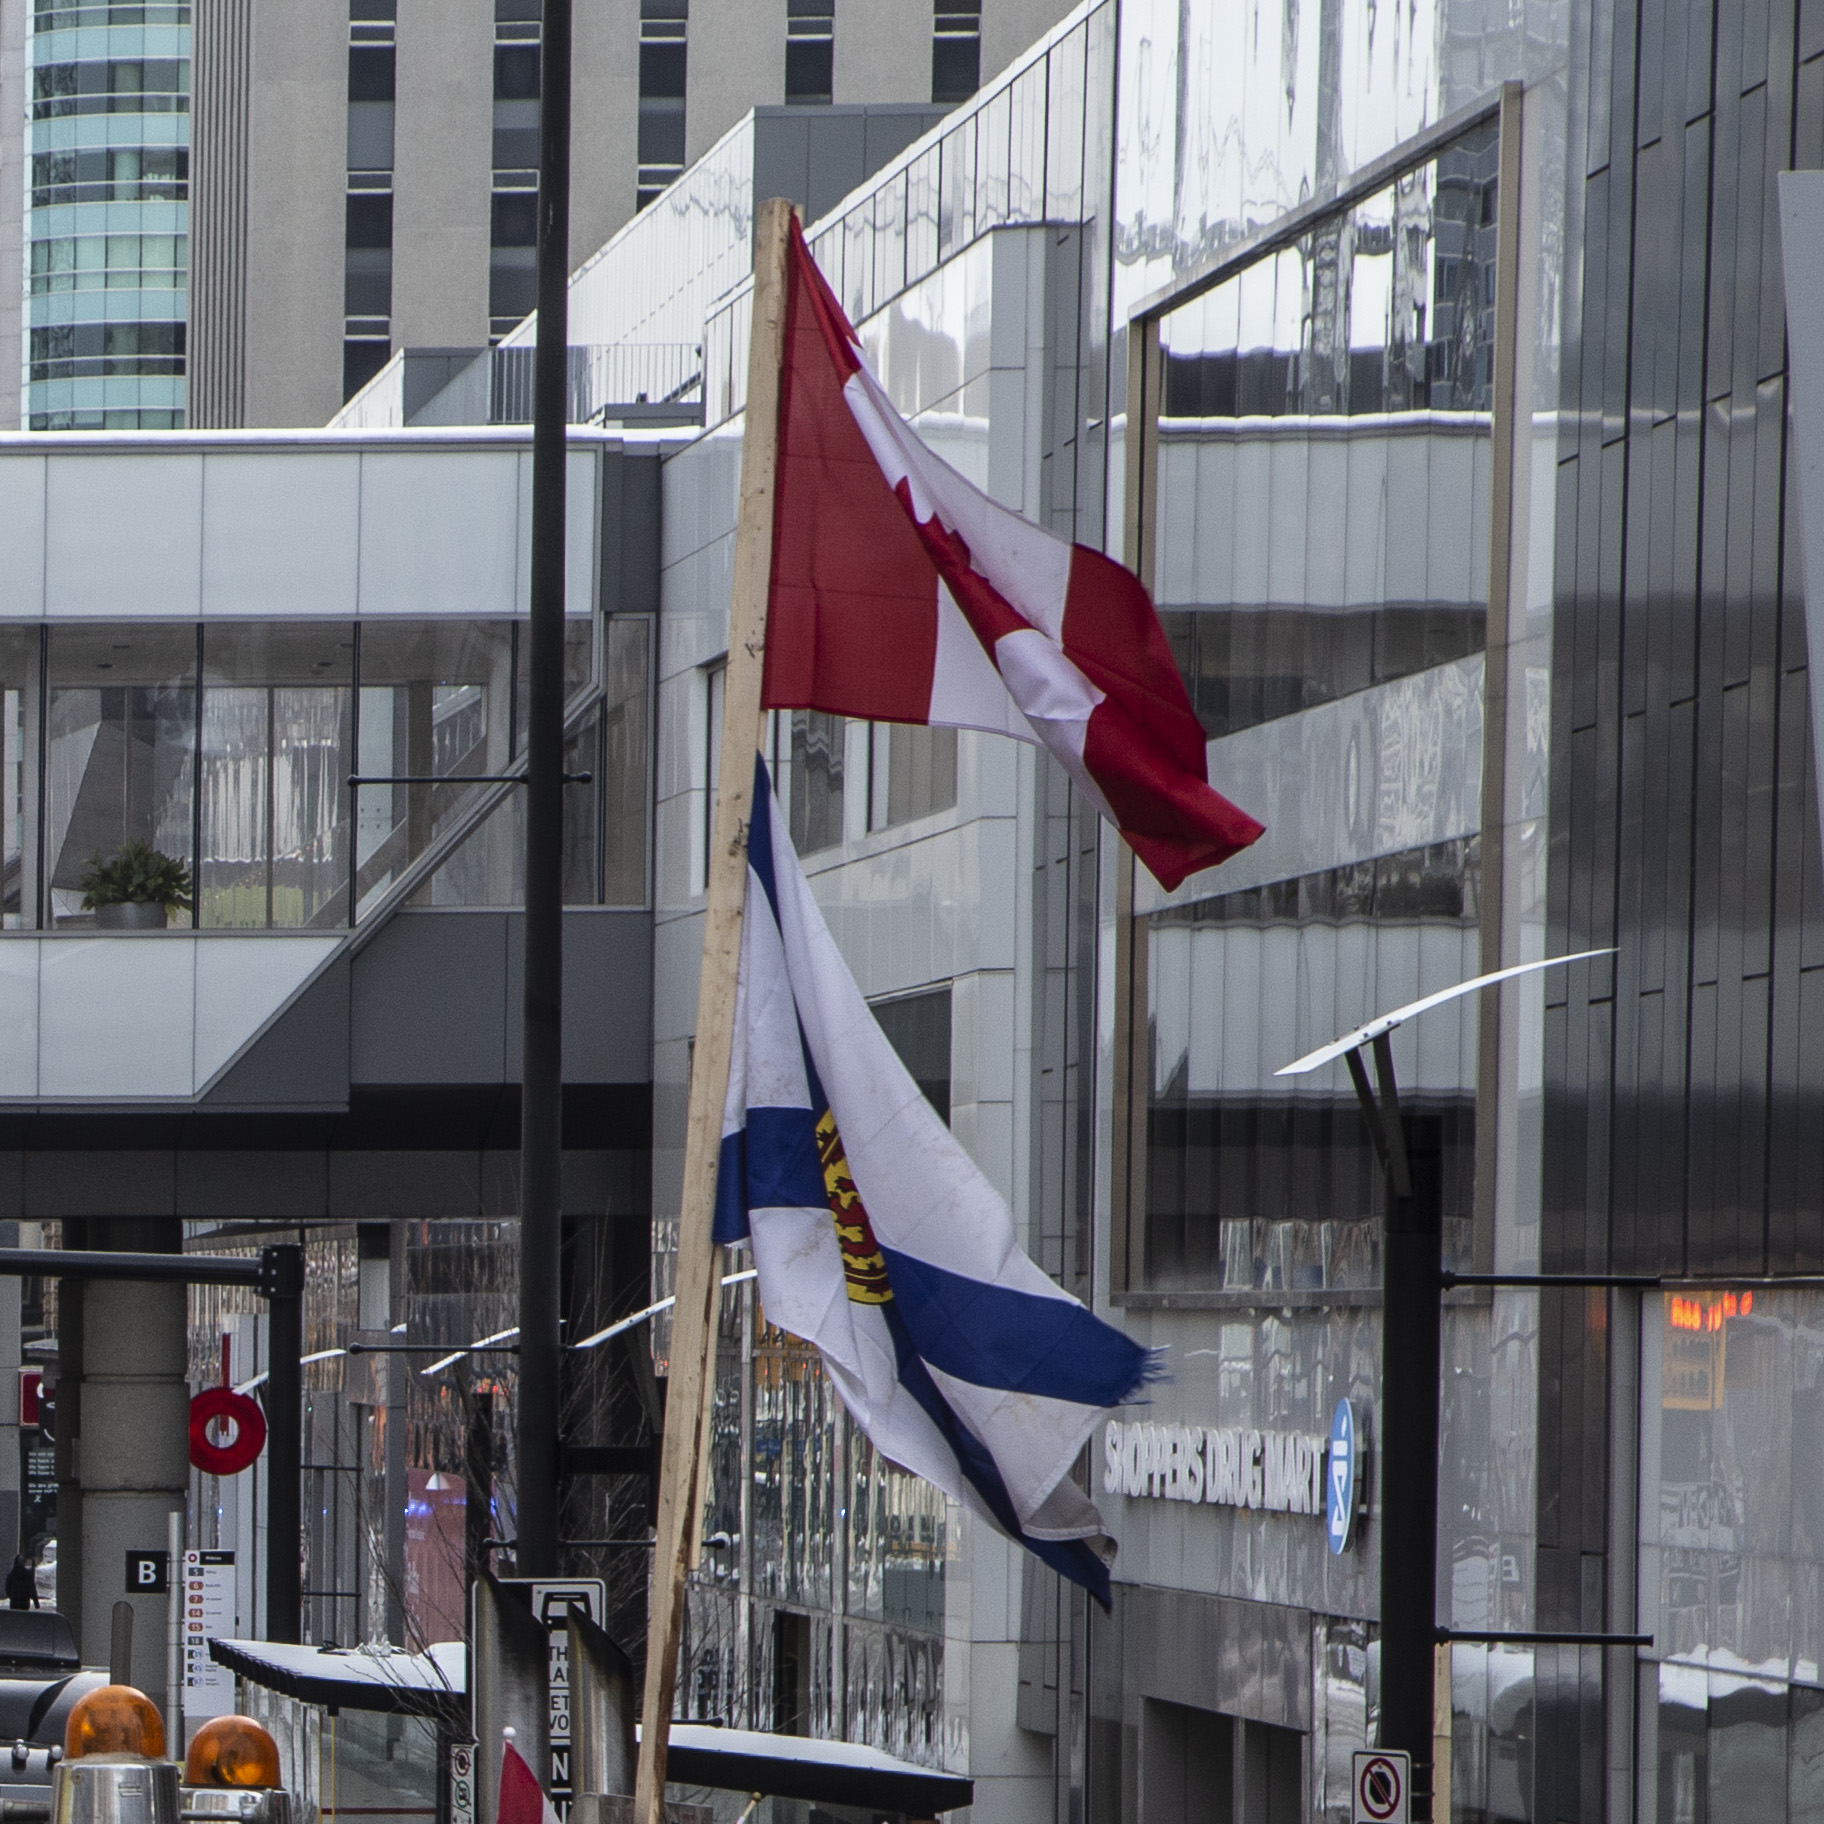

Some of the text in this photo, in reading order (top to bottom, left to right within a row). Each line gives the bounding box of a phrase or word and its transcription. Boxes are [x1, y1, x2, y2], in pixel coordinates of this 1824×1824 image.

[1104, 1419, 1326, 1515] SHOPPERS DRUG MART
[138, 1560, 157, 1584] B
[191, 1623, 201, 1631] 15
